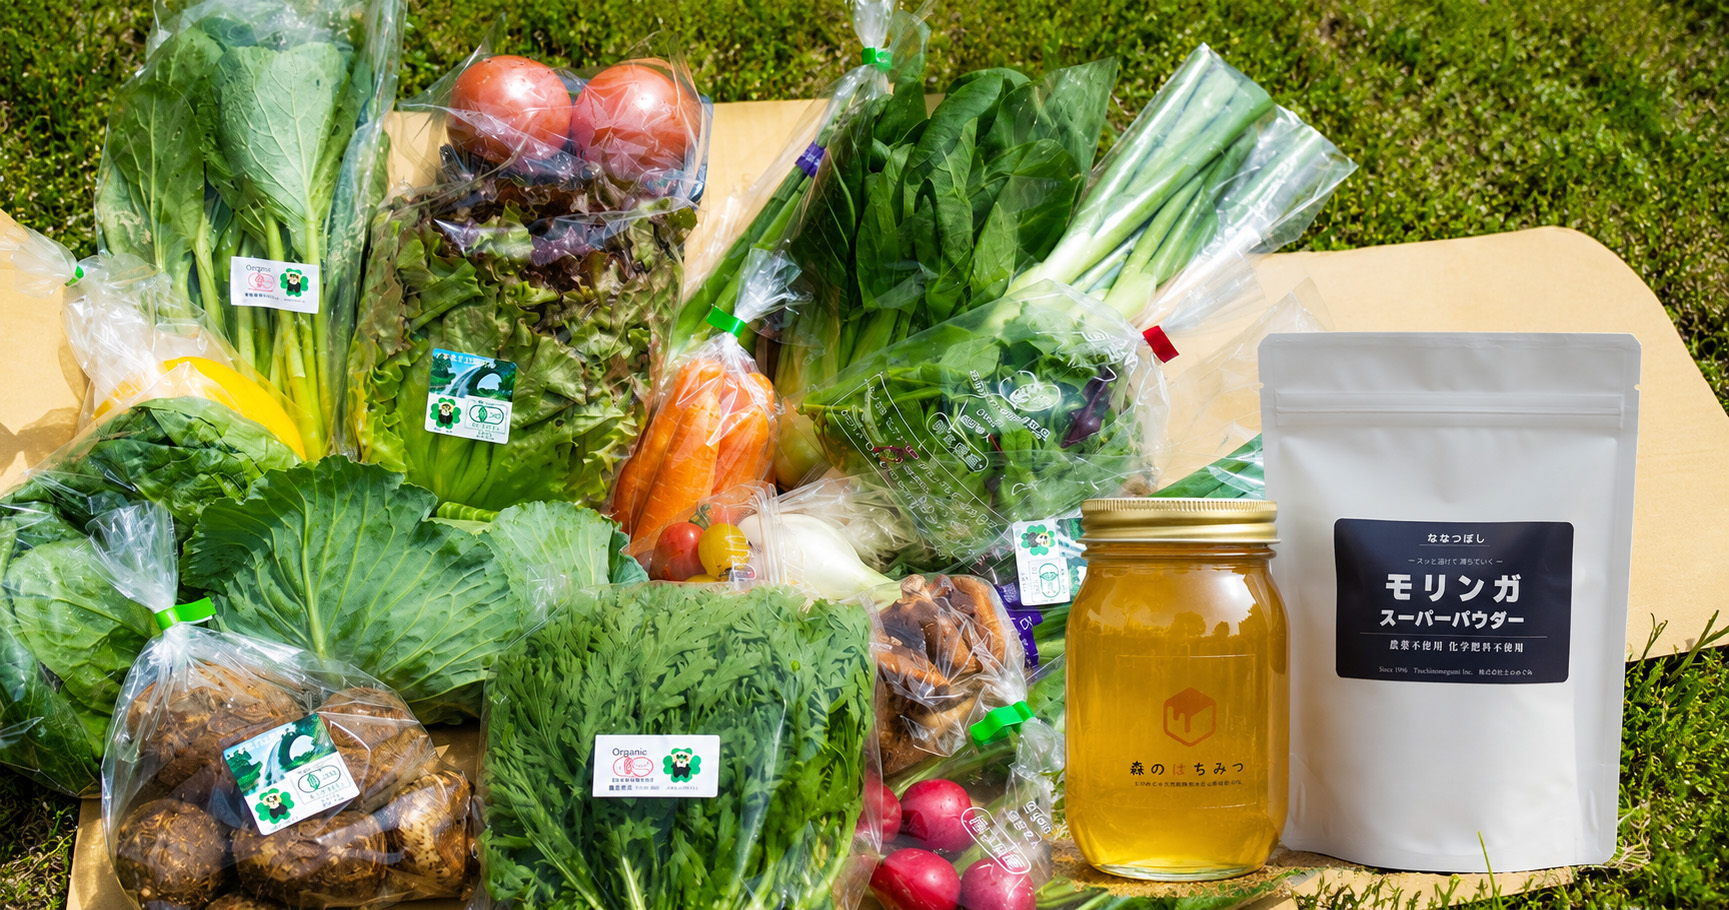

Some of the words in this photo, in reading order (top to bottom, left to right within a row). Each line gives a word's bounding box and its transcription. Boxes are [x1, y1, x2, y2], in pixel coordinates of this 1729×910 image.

[1427, 533, 1486, 544] ななつぼし
[1385, 573, 1522, 603] モリンガ
[1379, 609, 1525, 630] スーパーパウダー
[1389, 639, 1443, 652] 農薬不使用
[1449, 641, 1524, 654] 化学肥料不使用
[612, 747, 648, 758] Organic
[1129, 760, 1244, 776] 森のはちみつ
